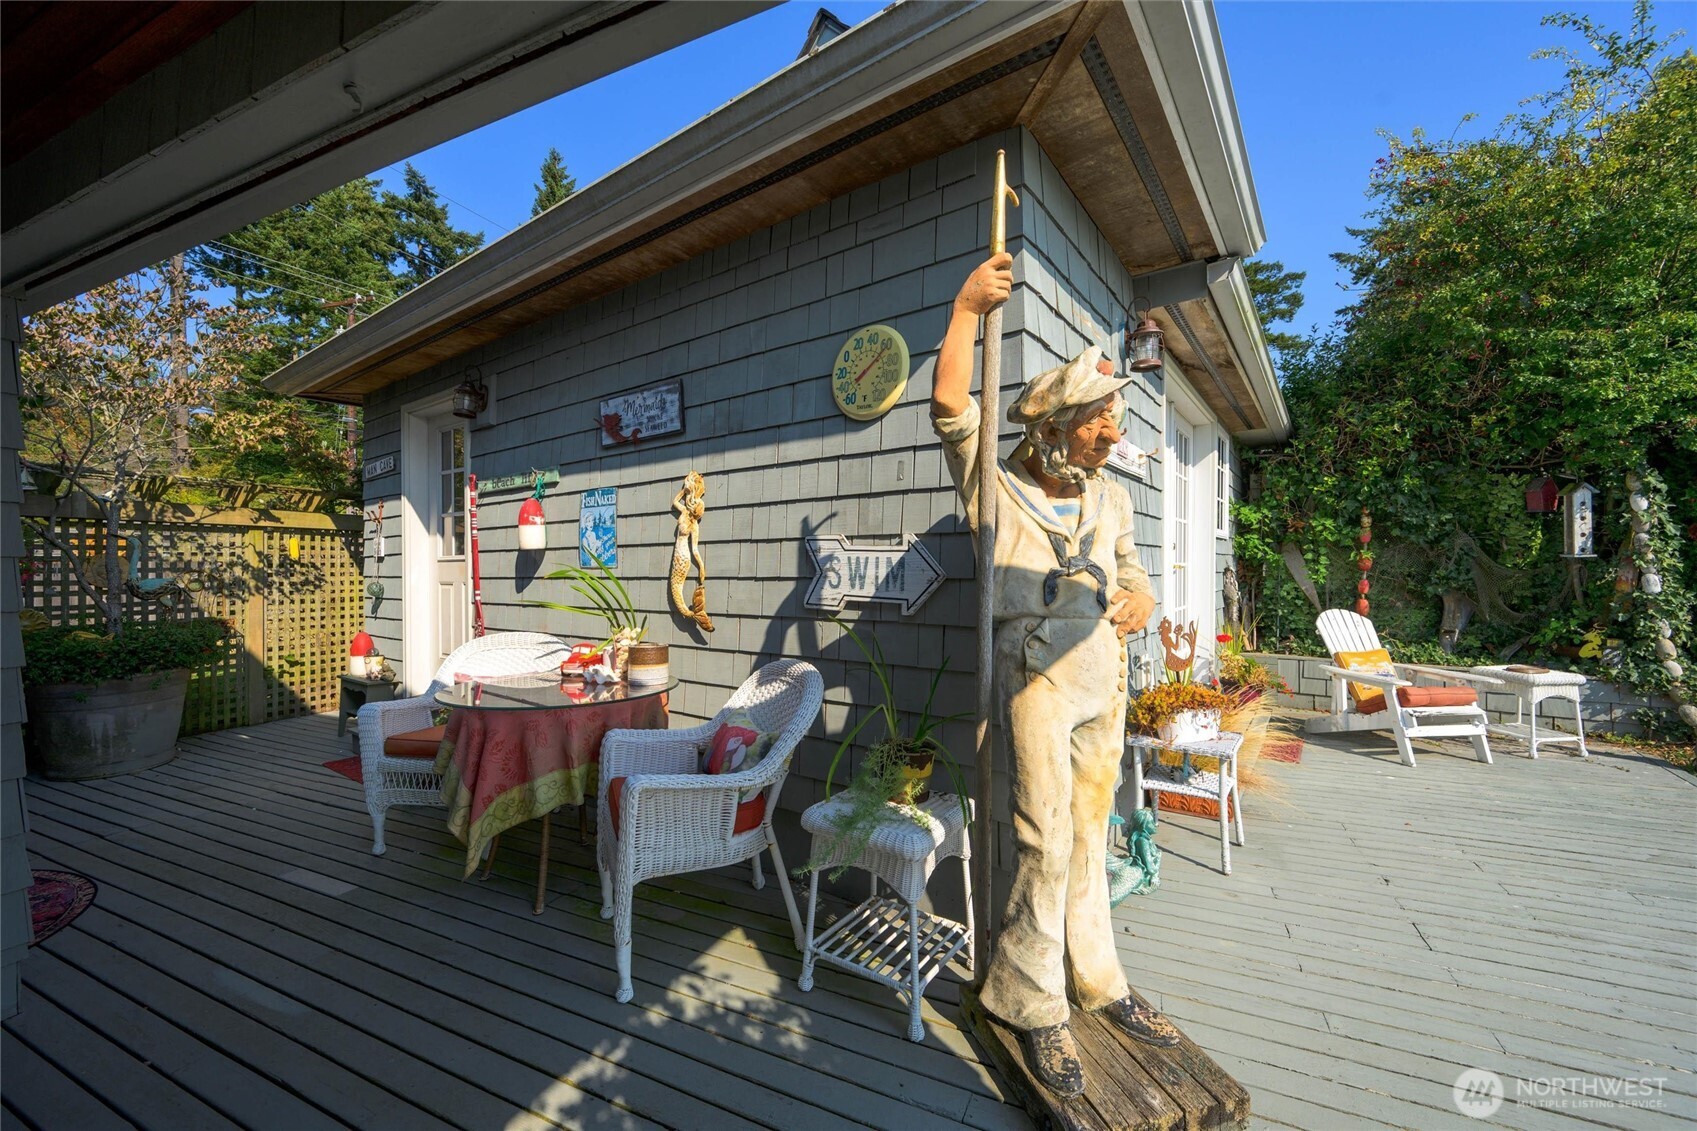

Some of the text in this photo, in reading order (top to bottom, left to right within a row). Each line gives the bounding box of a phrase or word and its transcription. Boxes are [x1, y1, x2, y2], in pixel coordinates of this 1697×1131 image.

[853, 337, 864, 351] 20
[867, 332, 879, 346] 40
[881, 338, 892, 350] 60
[844, 351, 850, 362] 0
[823, 555, 906, 592] SWIM
